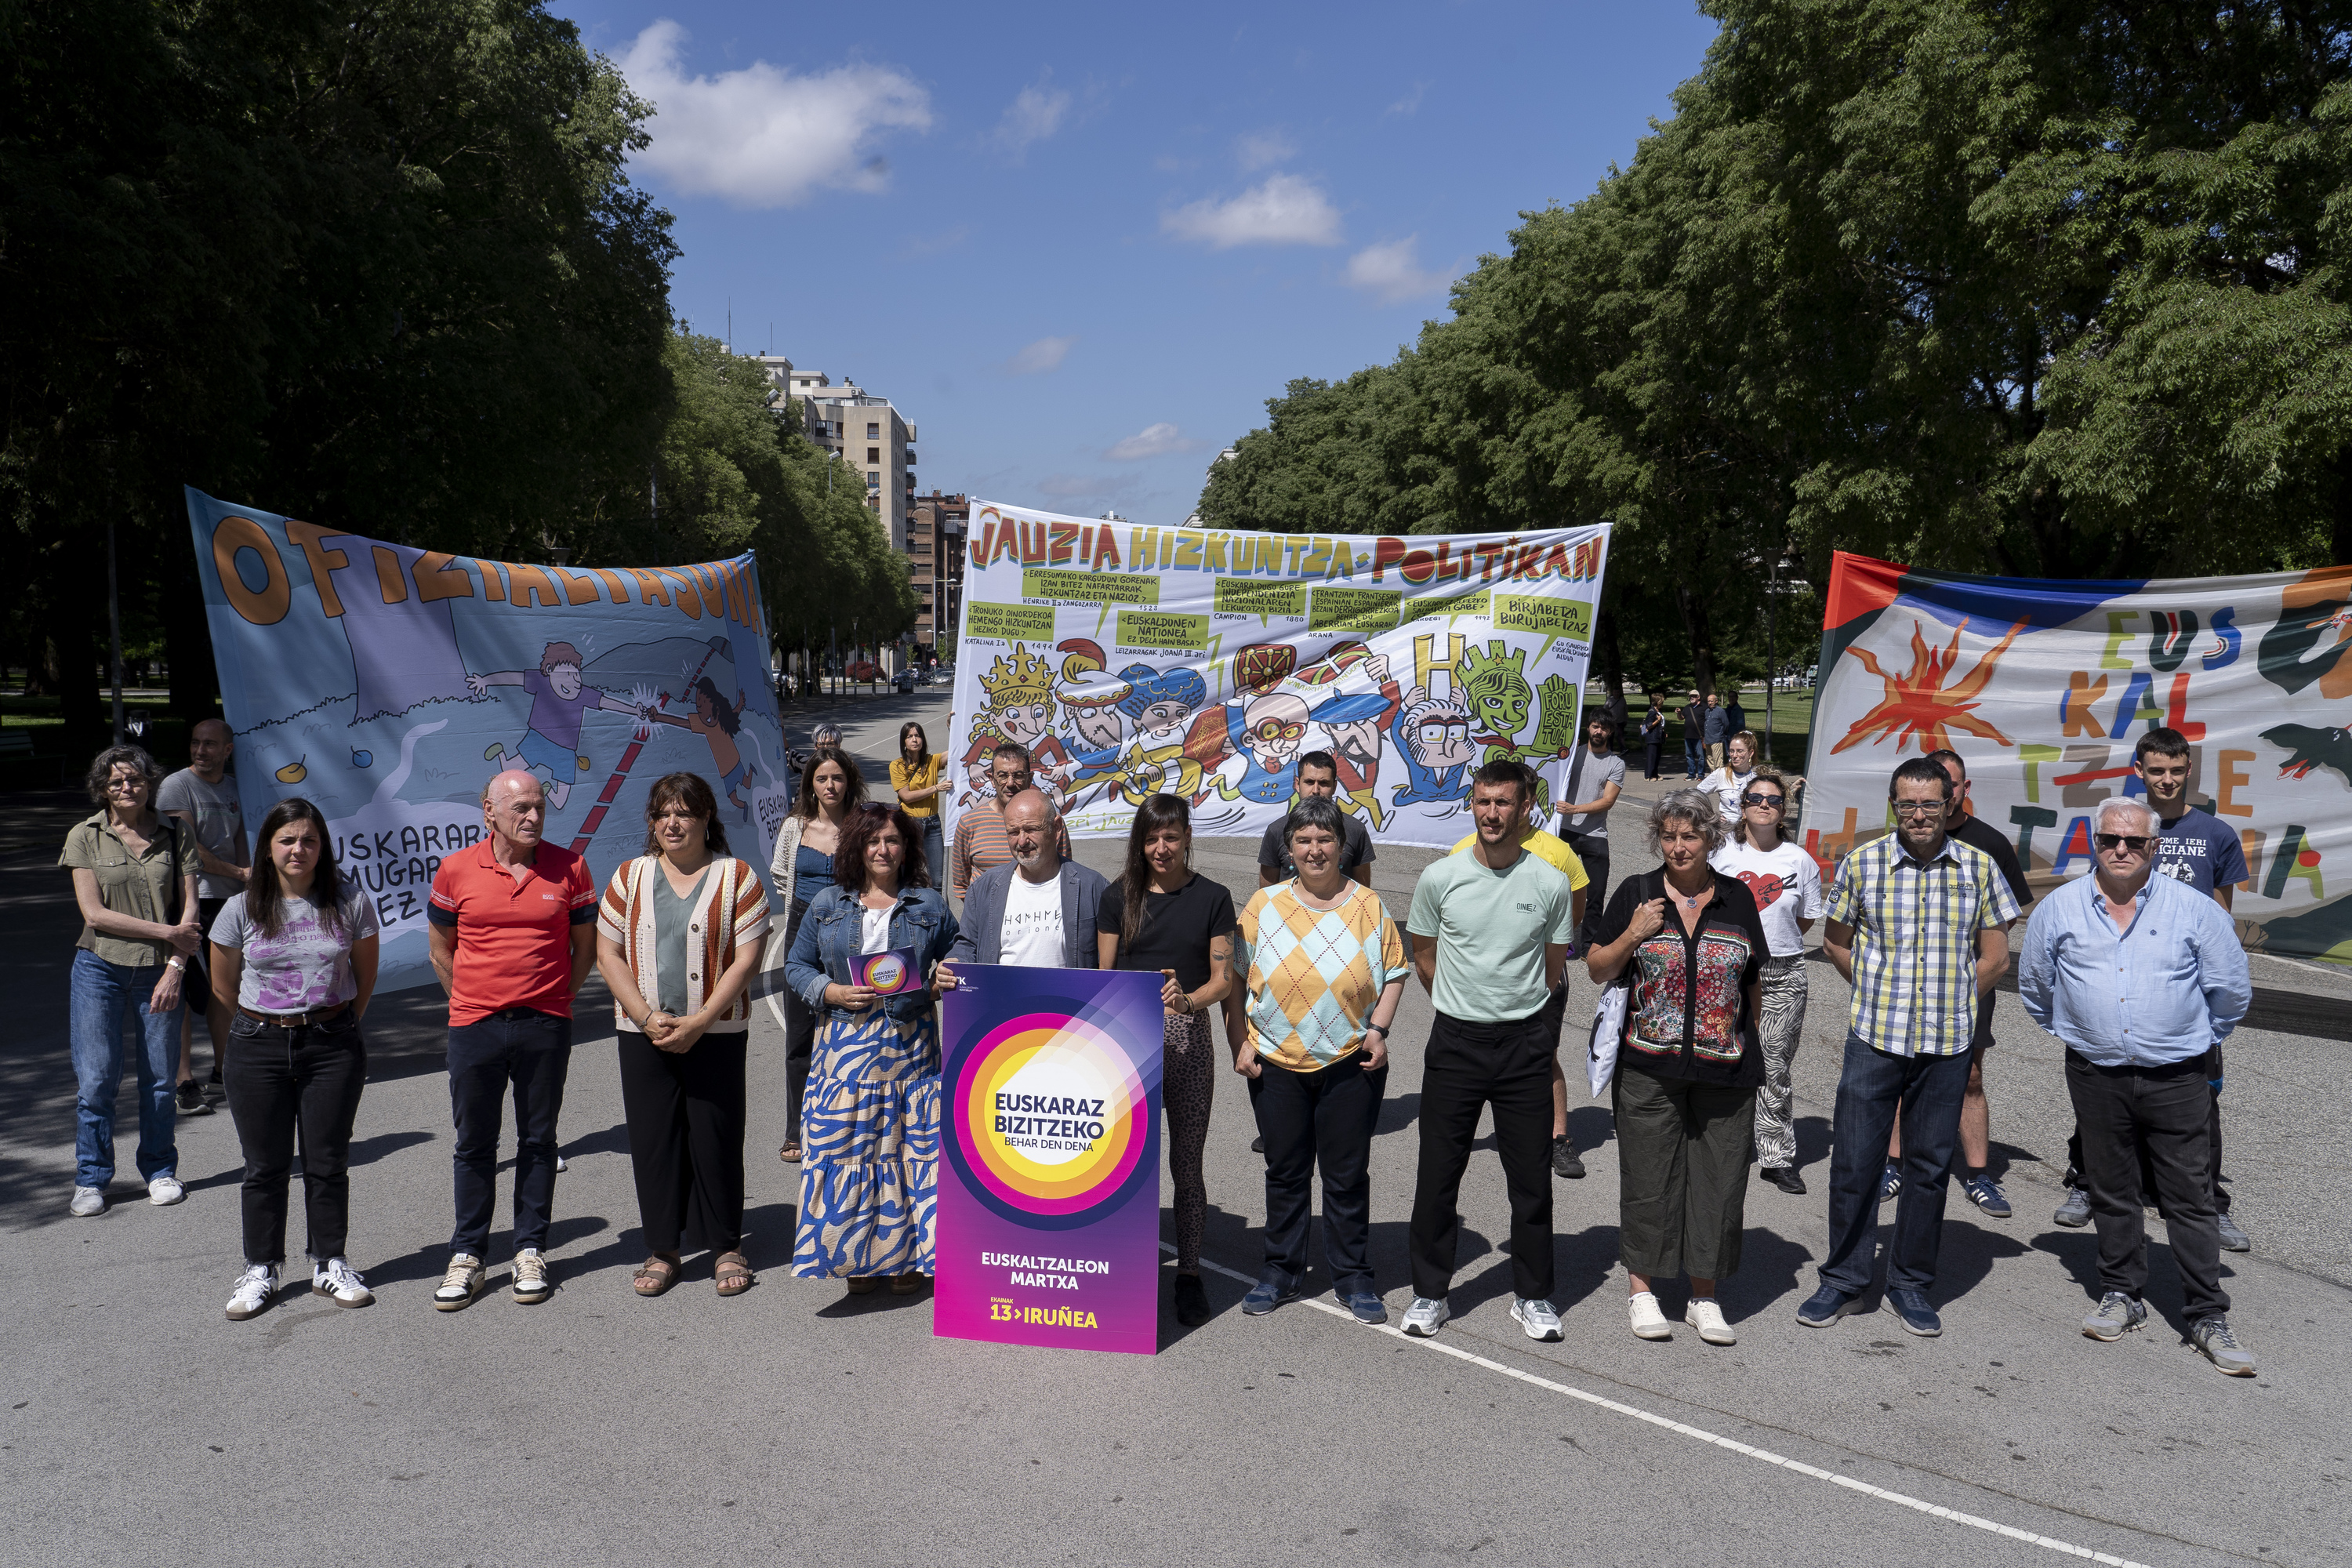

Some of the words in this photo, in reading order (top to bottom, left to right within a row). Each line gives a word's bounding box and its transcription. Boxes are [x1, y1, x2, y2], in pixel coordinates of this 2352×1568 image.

[969, 508, 1122, 574] JAUZIA
[1040, 579, 1058, 587] IZAN
[1086, 583, 1142, 593] NAFARTARRAK
[1079, 573, 1117, 583] KARGUDUN
[1120, 575, 1157, 586] GORENAK
[1040, 588, 1091, 600] HIZKUNTZAZ
[1092, 590, 1107, 601] ETA
[1222, 588, 1296, 599] INDEPENDENTZIA
[1022, 597, 1050, 606] HENRIKE
[1062, 600, 1102, 608] ZANGOZARRA
[1221, 596, 1291, 607] NAZIONALAREN
[1006, 609, 1052, 619] OINORDEKOA
[1221, 604, 1265, 613] LEKUKOTZA
[968, 615, 1004, 626] HEMENGO
[1005, 617, 1052, 630] HIZKUNTZAN
[1214, 612, 1247, 621] CAMPION
[973, 626, 998, 634] HEZIKO
[1312, 619, 1352, 628] ABERRIAN
[1138, 626, 1187, 639] NATIONEA
[964, 637, 994, 647] KATALINA
[1159, 637, 1176, 646] HAIN
[2100, 606, 2241, 673] EUS
[1031, 642, 1053, 651] 1494
[1115, 647, 1158, 655] LEIZARRAGAK
[1160, 648, 1183, 658] JOANA
[1552, 646, 1591, 658] EUSKALDUNON
[1566, 641, 1589, 652] GAURKO
[1555, 653, 1573, 662] ALDIA
[1544, 691, 1573, 710] FORU
[2060, 671, 2206, 742] KAL
[1543, 710, 1574, 730] ESTA
[1542, 728, 1567, 746] TUA
[2185, 837, 2207, 846] IERI
[2009, 805, 2324, 900] TAA
[2155, 844, 2206, 857] IGIANE
[376, 890, 423, 927] EZ
[1516, 902, 1537, 913] OINEZ
[873, 968, 897, 977] EUSKARAZ
[994, 1093, 1105, 1118] EUSKARAZ
[994, 1115, 1105, 1140] BIZITZEKO
[1004, 1136, 1038, 1150] BEHAR
[1040, 1138, 1063, 1151] DEN
[1065, 1139, 1094, 1152] DENA
[982, 1251, 1109, 1275] EUSKALTZALEON
[1011, 1271, 1079, 1290] MARTXA
[1024, 1305, 1098, 1329] IRUÑEA
